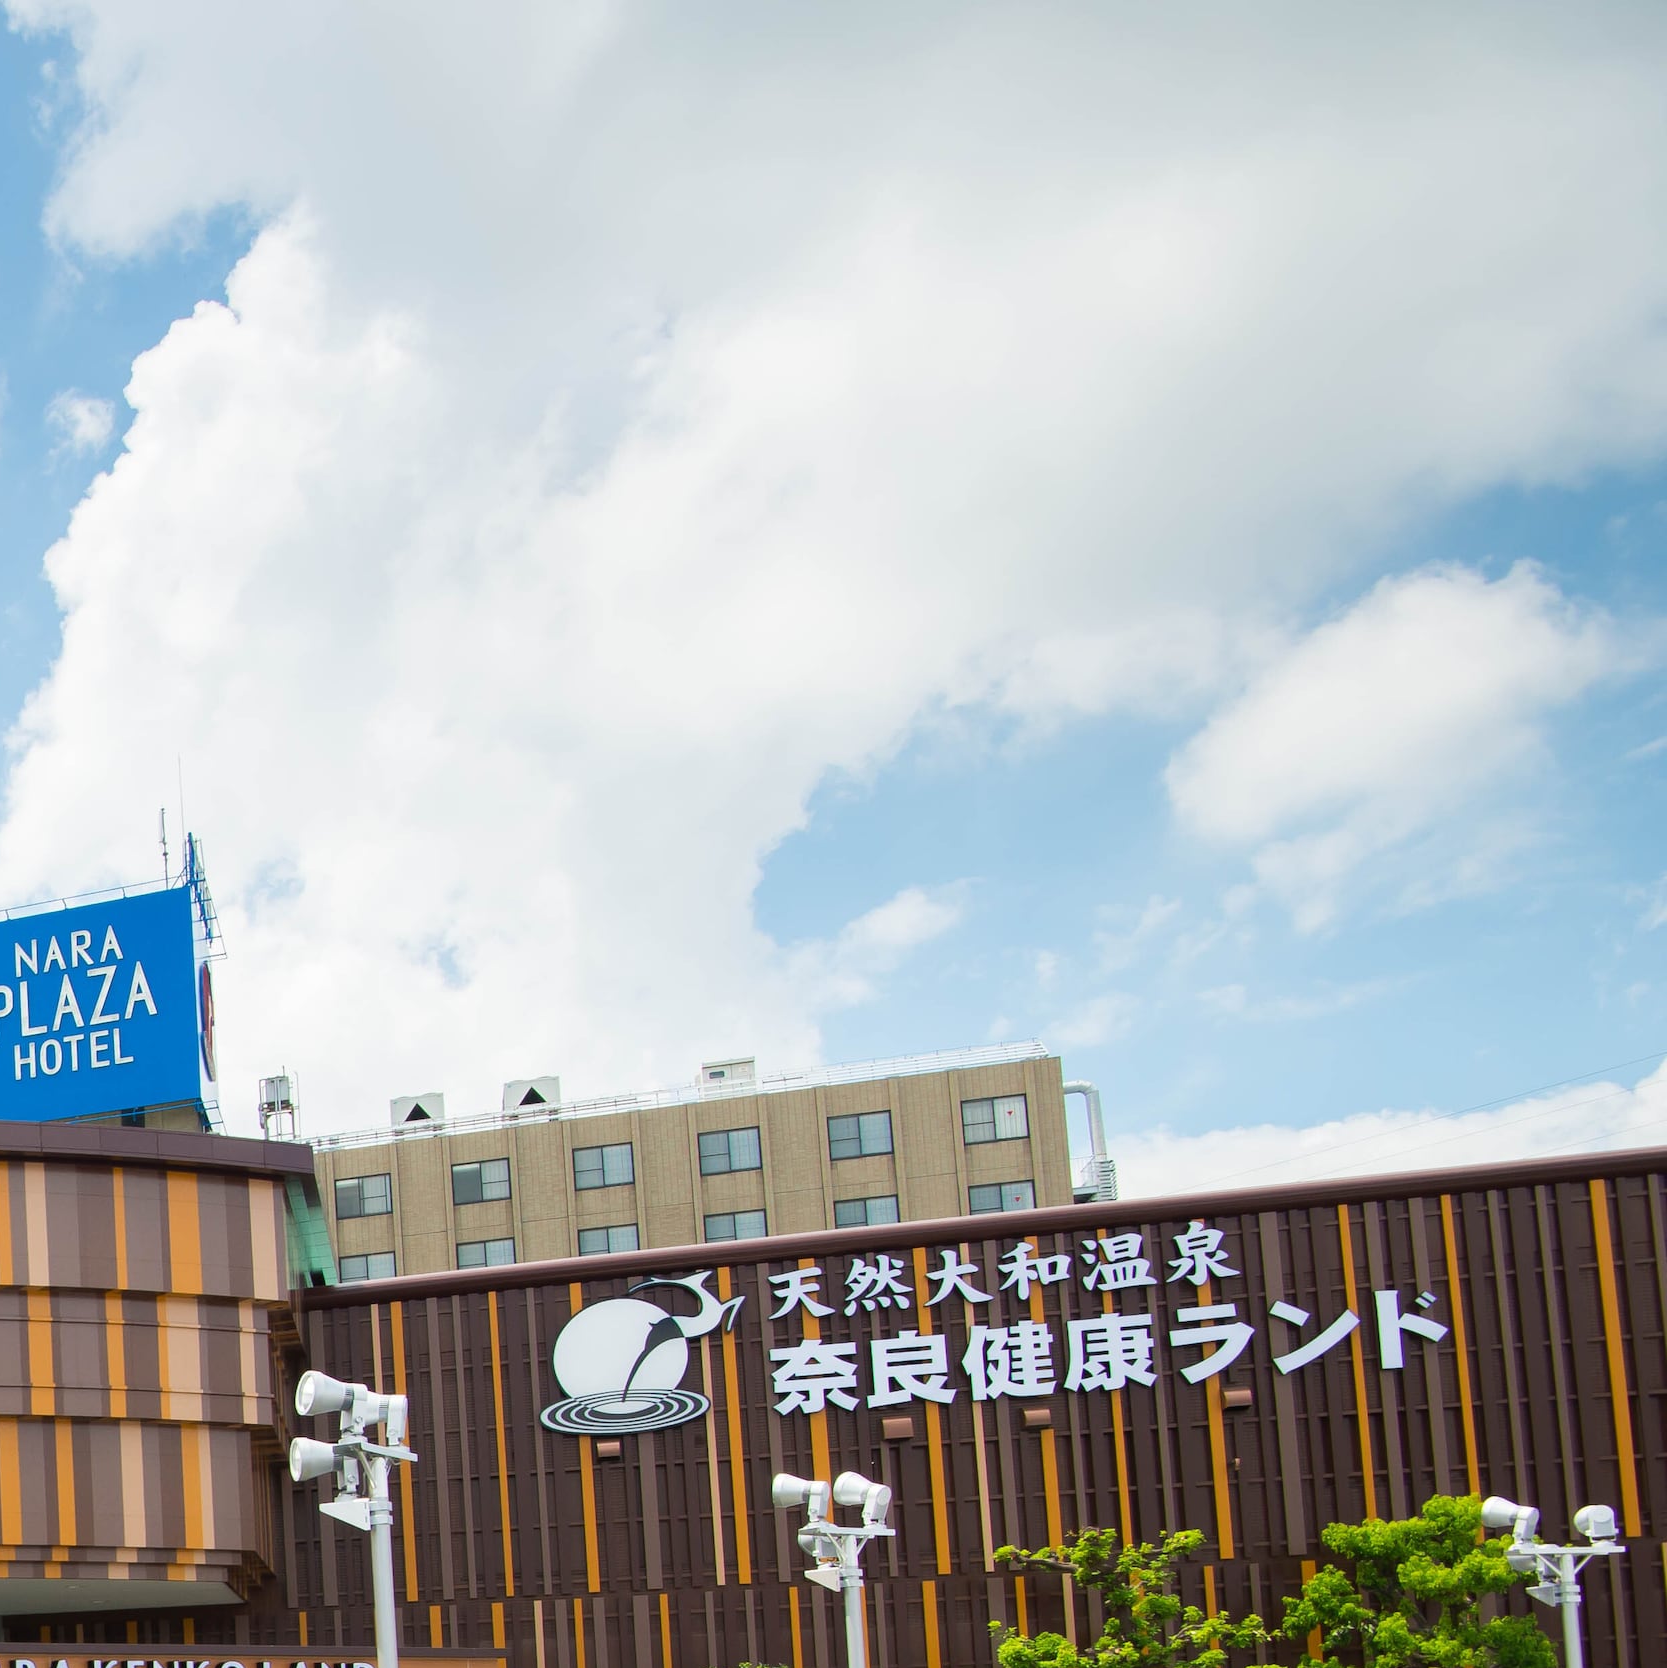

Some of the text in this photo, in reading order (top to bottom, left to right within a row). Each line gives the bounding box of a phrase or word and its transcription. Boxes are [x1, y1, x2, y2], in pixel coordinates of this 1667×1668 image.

[14, 924, 124, 978] NARA
[13, 1028, 134, 1081] HOTEL
[767, 1219, 1241, 1322] 天然大和温泉
[768, 1288, 1449, 1416] 奈良健康ランド
